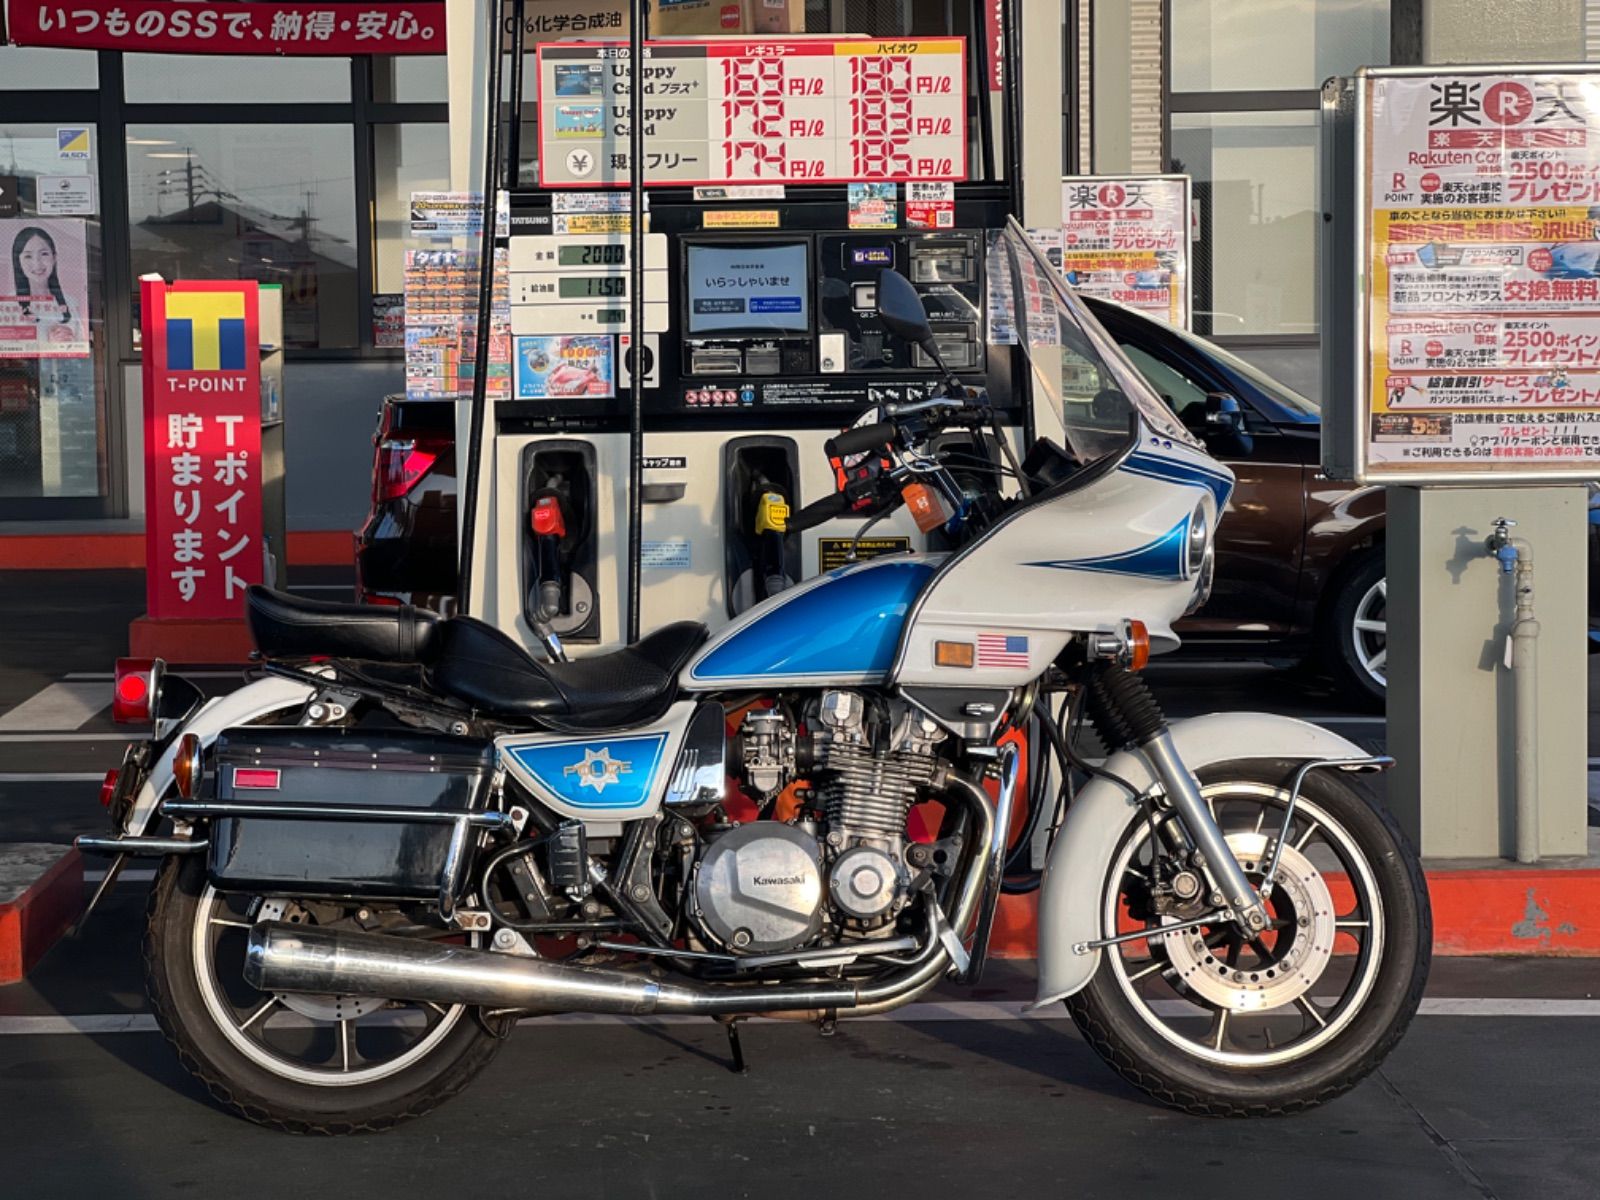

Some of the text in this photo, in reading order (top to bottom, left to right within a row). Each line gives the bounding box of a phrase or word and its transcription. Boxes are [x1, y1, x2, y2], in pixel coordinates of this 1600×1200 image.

[38, 6, 436, 41] いつものSSで、納得・安心。
[597, 47, 652, 59] 本日の格
[745, 46, 796, 56] レギュラー
[877, 43, 918, 54] ハイオク
[720, 58, 784, 97] 169
[849, 56, 912, 95] 180
[721, 99, 785, 138] 172
[849, 96, 912, 136] 183
[611, 153, 698, 169] 現フリー
[721, 141, 786, 178] 174
[849, 138, 913, 177] 185
[1409, 150, 1502, 168] Rakuten Car
[1393, 172, 1406, 189] R
[1384, 193, 1415, 202] POINT
[1420, 193, 1502, 204] 実施のお客様に
[511, 216, 549, 224] TATSUNO
[582, 246, 624, 263] 2000
[705, 277, 791, 287] いらっしゃいませ
[1414, 321, 1497, 337] Rakuten Car
[1393, 357, 1420, 365] POINT
[167, 377, 247, 393] T-POINT
[167, 413, 206, 602] 貯まります
[213, 415, 251, 600] Tポイント
[753, 872, 806, 886] Kawasaki
